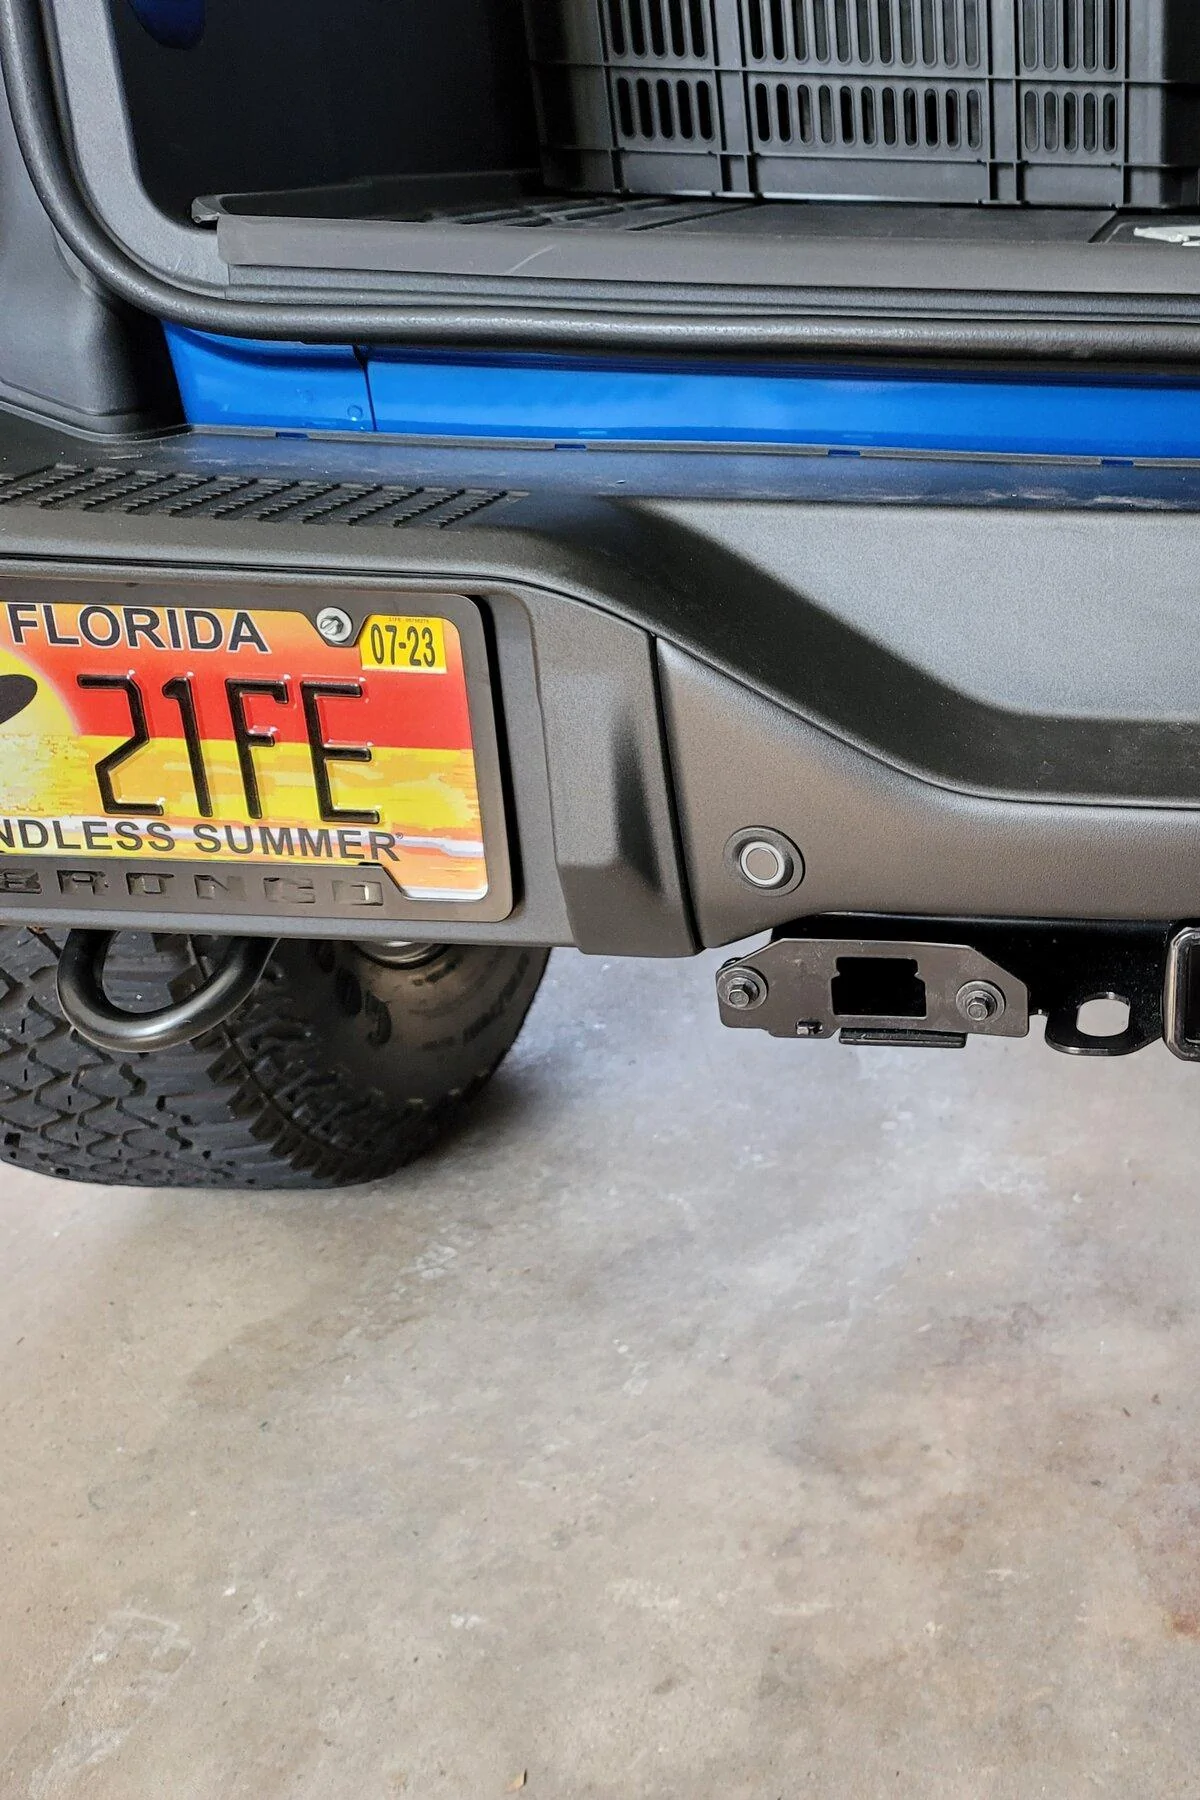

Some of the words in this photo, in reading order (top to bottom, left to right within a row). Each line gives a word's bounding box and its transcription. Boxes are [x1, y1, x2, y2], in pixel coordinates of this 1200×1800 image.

[5, 602, 271, 654] FLORIDA
[370, 623, 436, 667] 07-23
[76, 673, 380, 824] 21FE
